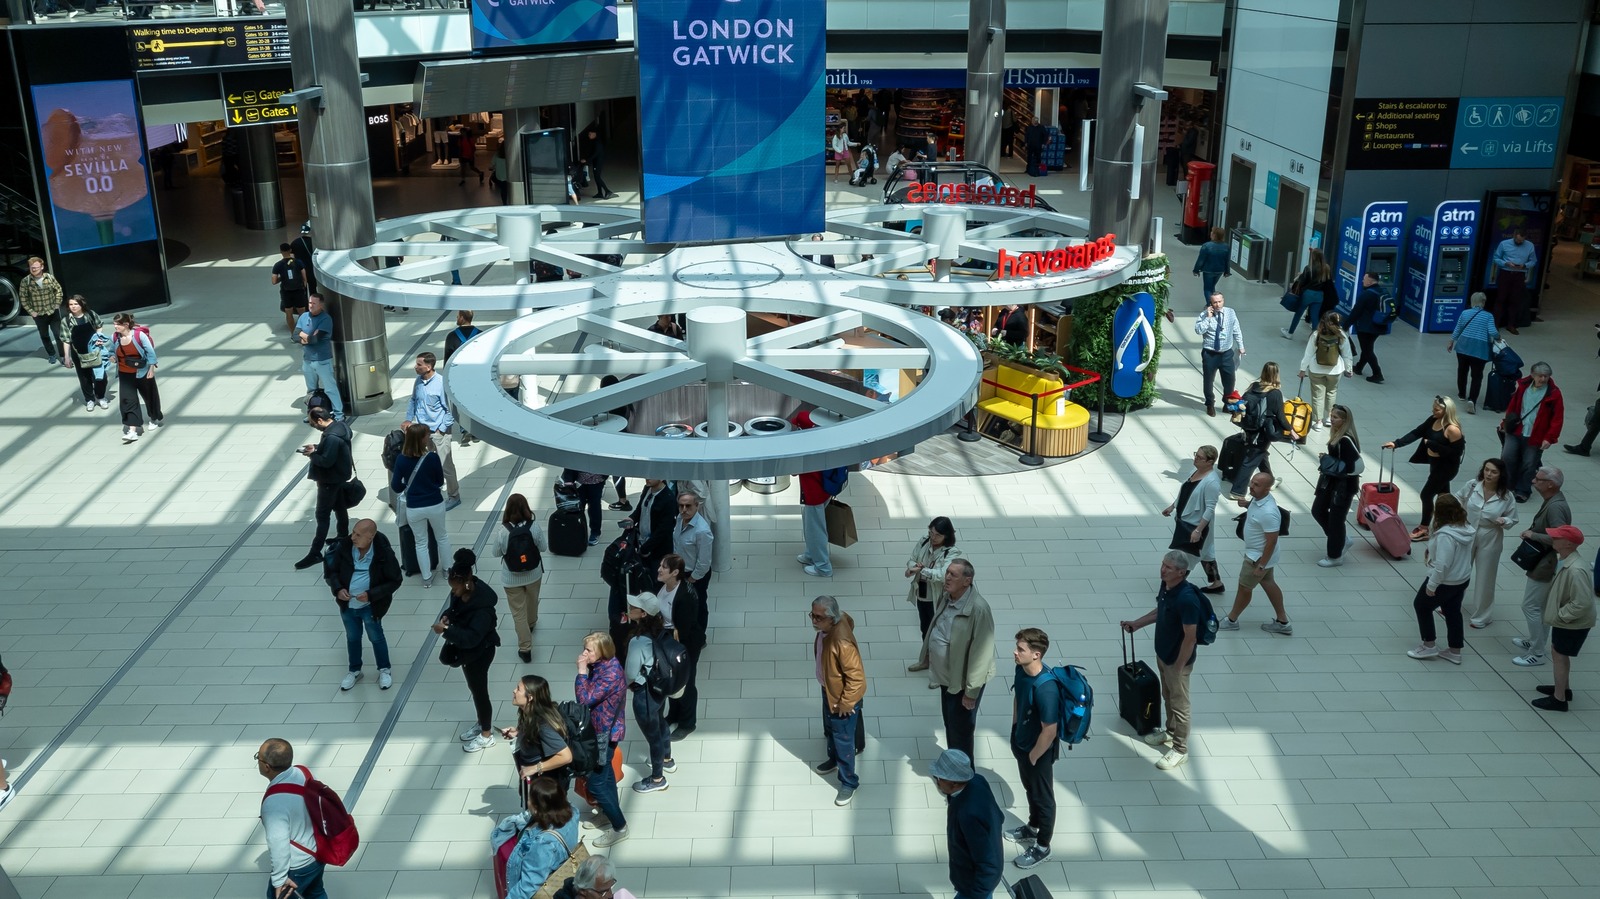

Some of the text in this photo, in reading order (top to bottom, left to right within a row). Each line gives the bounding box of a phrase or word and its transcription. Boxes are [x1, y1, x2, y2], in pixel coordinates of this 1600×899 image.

[133, 28, 160, 36] Walking
[673, 18, 793, 40] LONDON
[672, 44, 794, 66] GATWICK
[1004, 68, 1075, 85] HSmith
[262, 108, 289, 117] Gates
[368, 114, 388, 125] BOSS
[65, 144, 122, 156] WITH NEW
[1503, 140, 1553, 153] via Lifts
[64, 159, 128, 177] SEVILLA
[86, 175, 113, 194] 0.0
[1370, 210, 1403, 223] atm
[1442, 208, 1475, 221] atm
[1345, 226, 1360, 242] atm
[1415, 224, 1431, 240] atm
[998, 233, 1116, 279] havaianas
